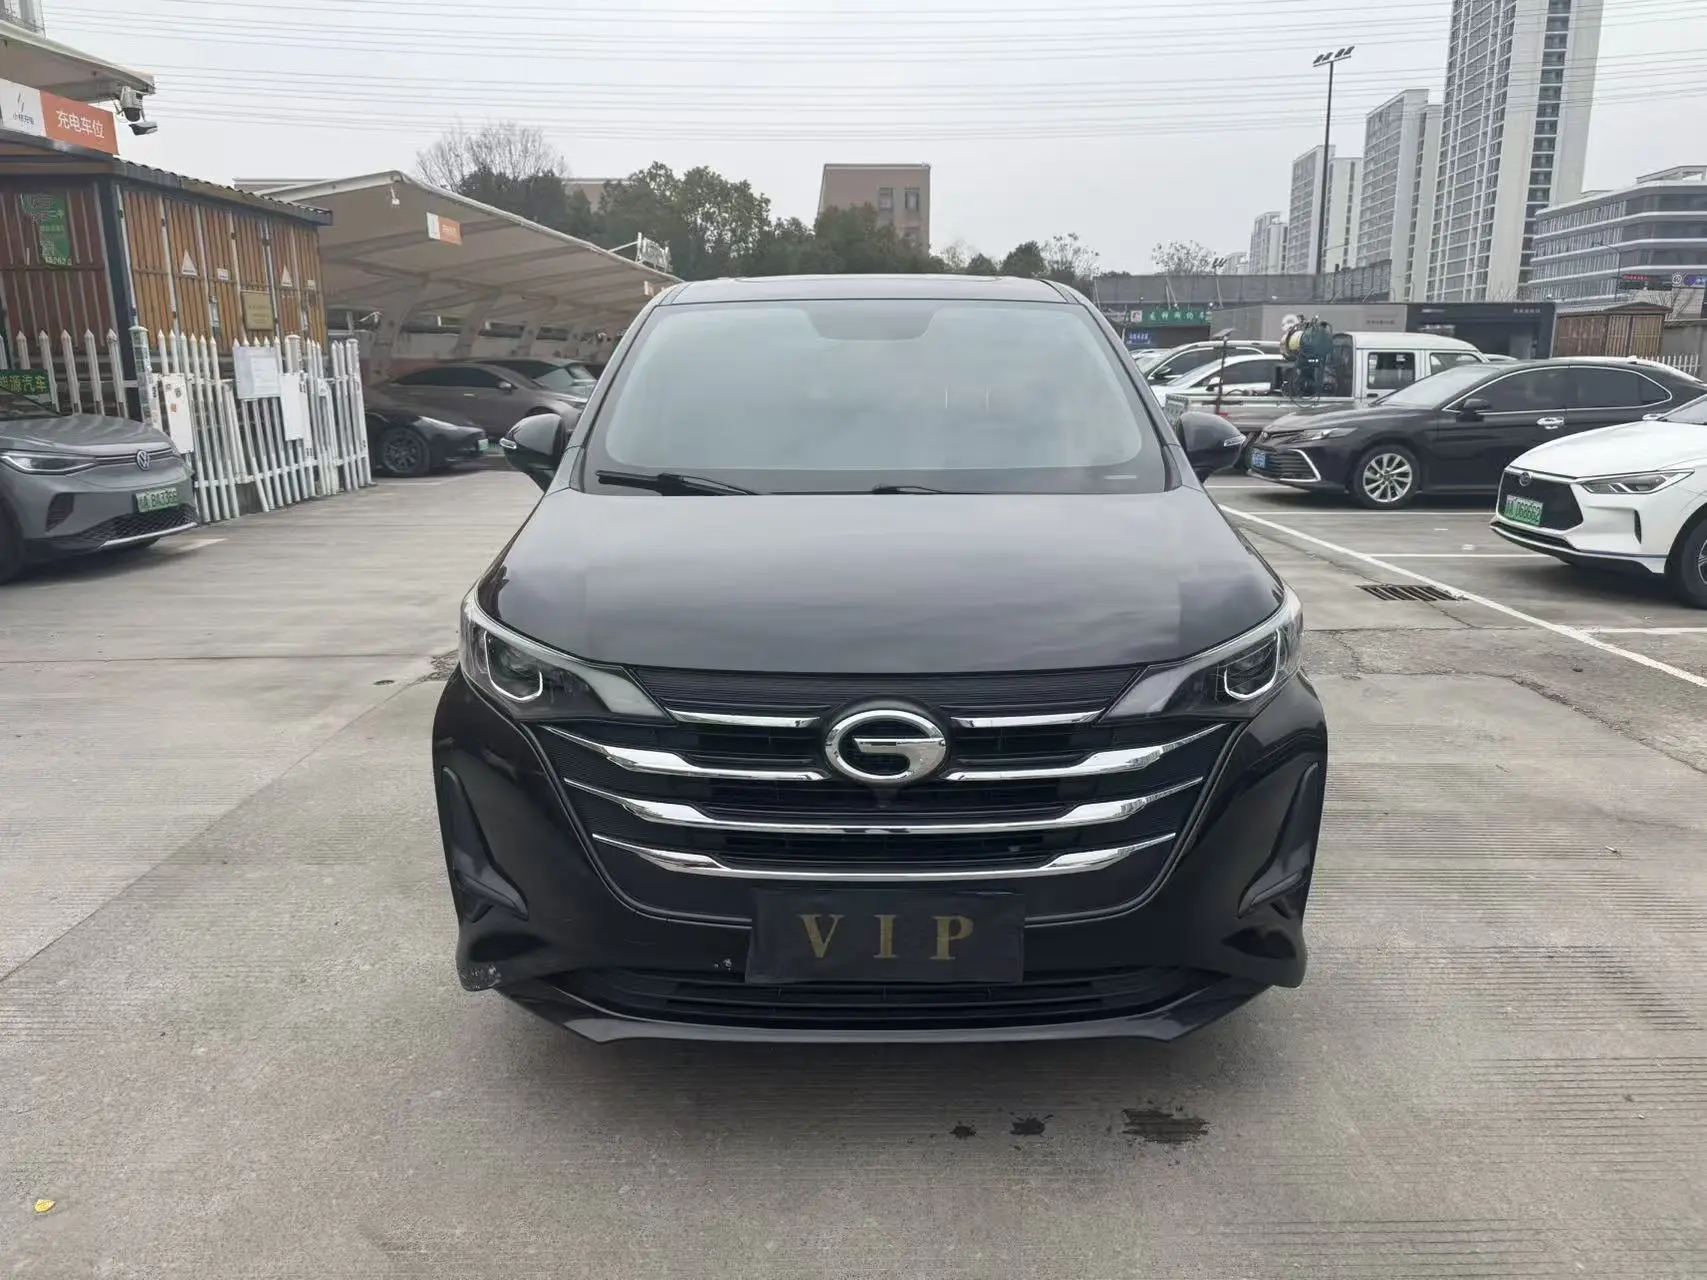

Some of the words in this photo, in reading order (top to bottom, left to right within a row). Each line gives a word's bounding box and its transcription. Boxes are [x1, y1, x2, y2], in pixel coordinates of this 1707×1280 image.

[56, 109, 105, 138] 充电车位
[798, 914, 974, 960] VIP
